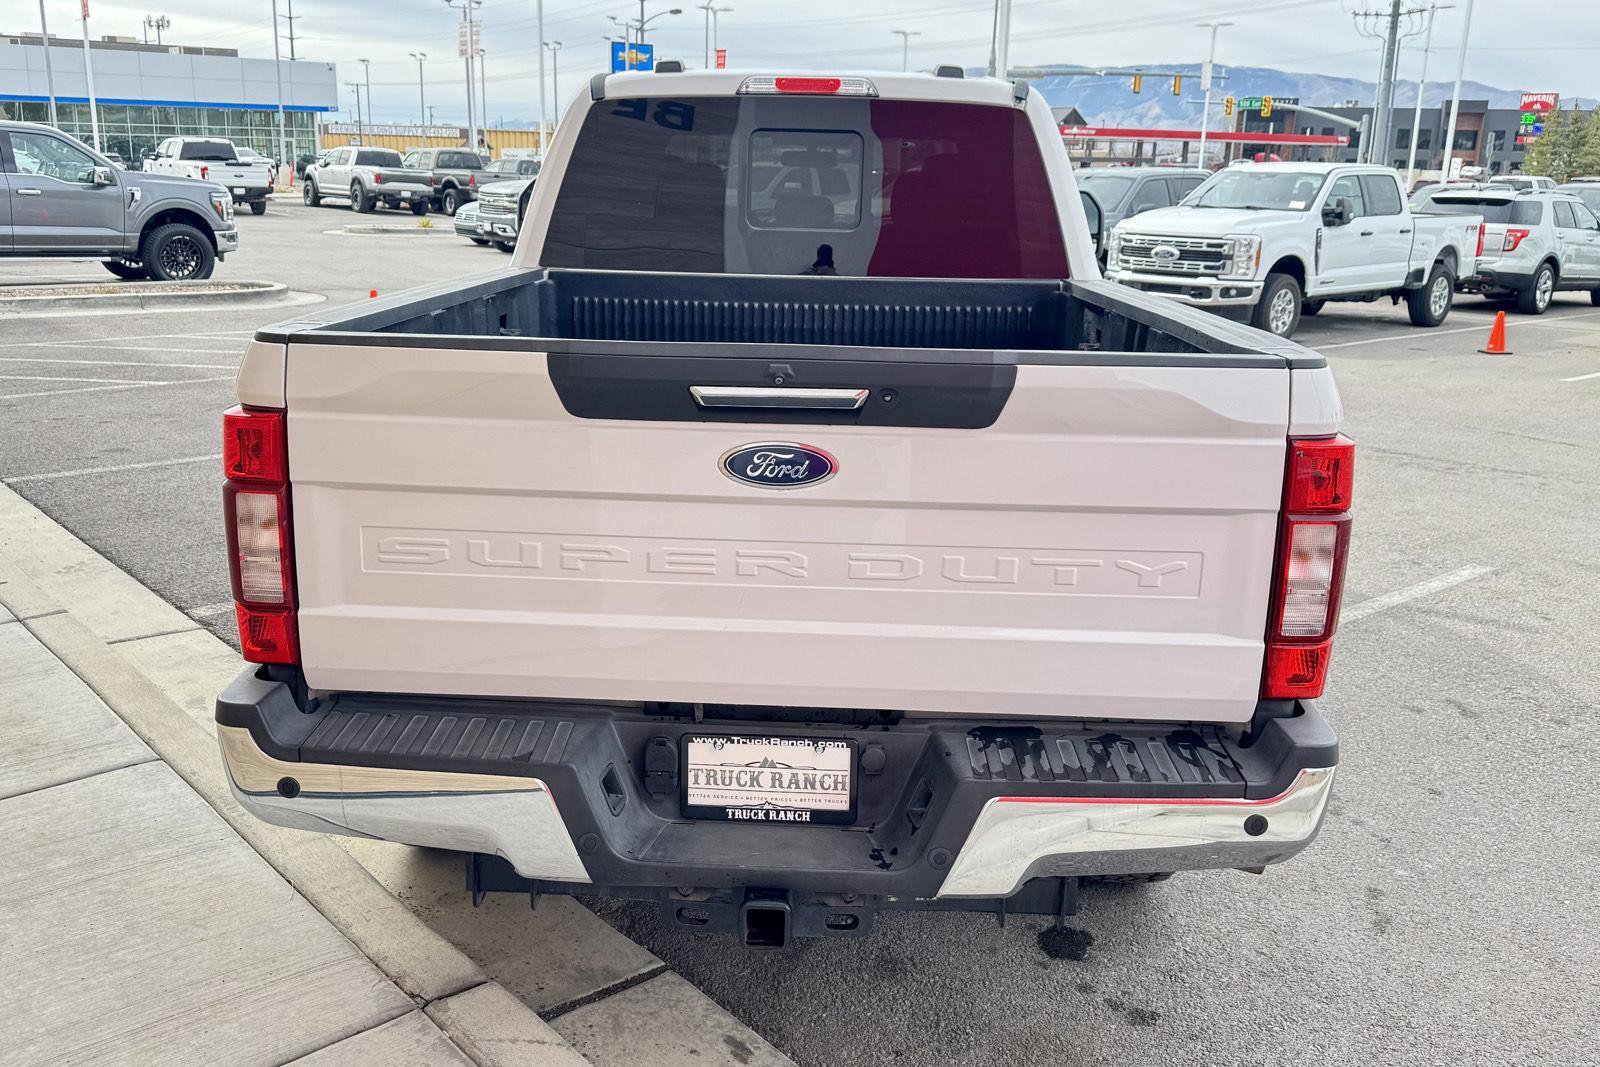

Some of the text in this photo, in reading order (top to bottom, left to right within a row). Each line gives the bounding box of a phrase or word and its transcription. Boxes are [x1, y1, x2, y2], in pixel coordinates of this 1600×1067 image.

[1521, 94, 1556, 107] MAVERIK
[746, 451, 810, 478] Ford
[377, 536, 1188, 588] SUPER DUTY
[692, 736, 847, 748] www.TruckRanch.com
[688, 768, 848, 792] TRUCK RANCH
[726, 808, 811, 822] TRUCK RANCH
